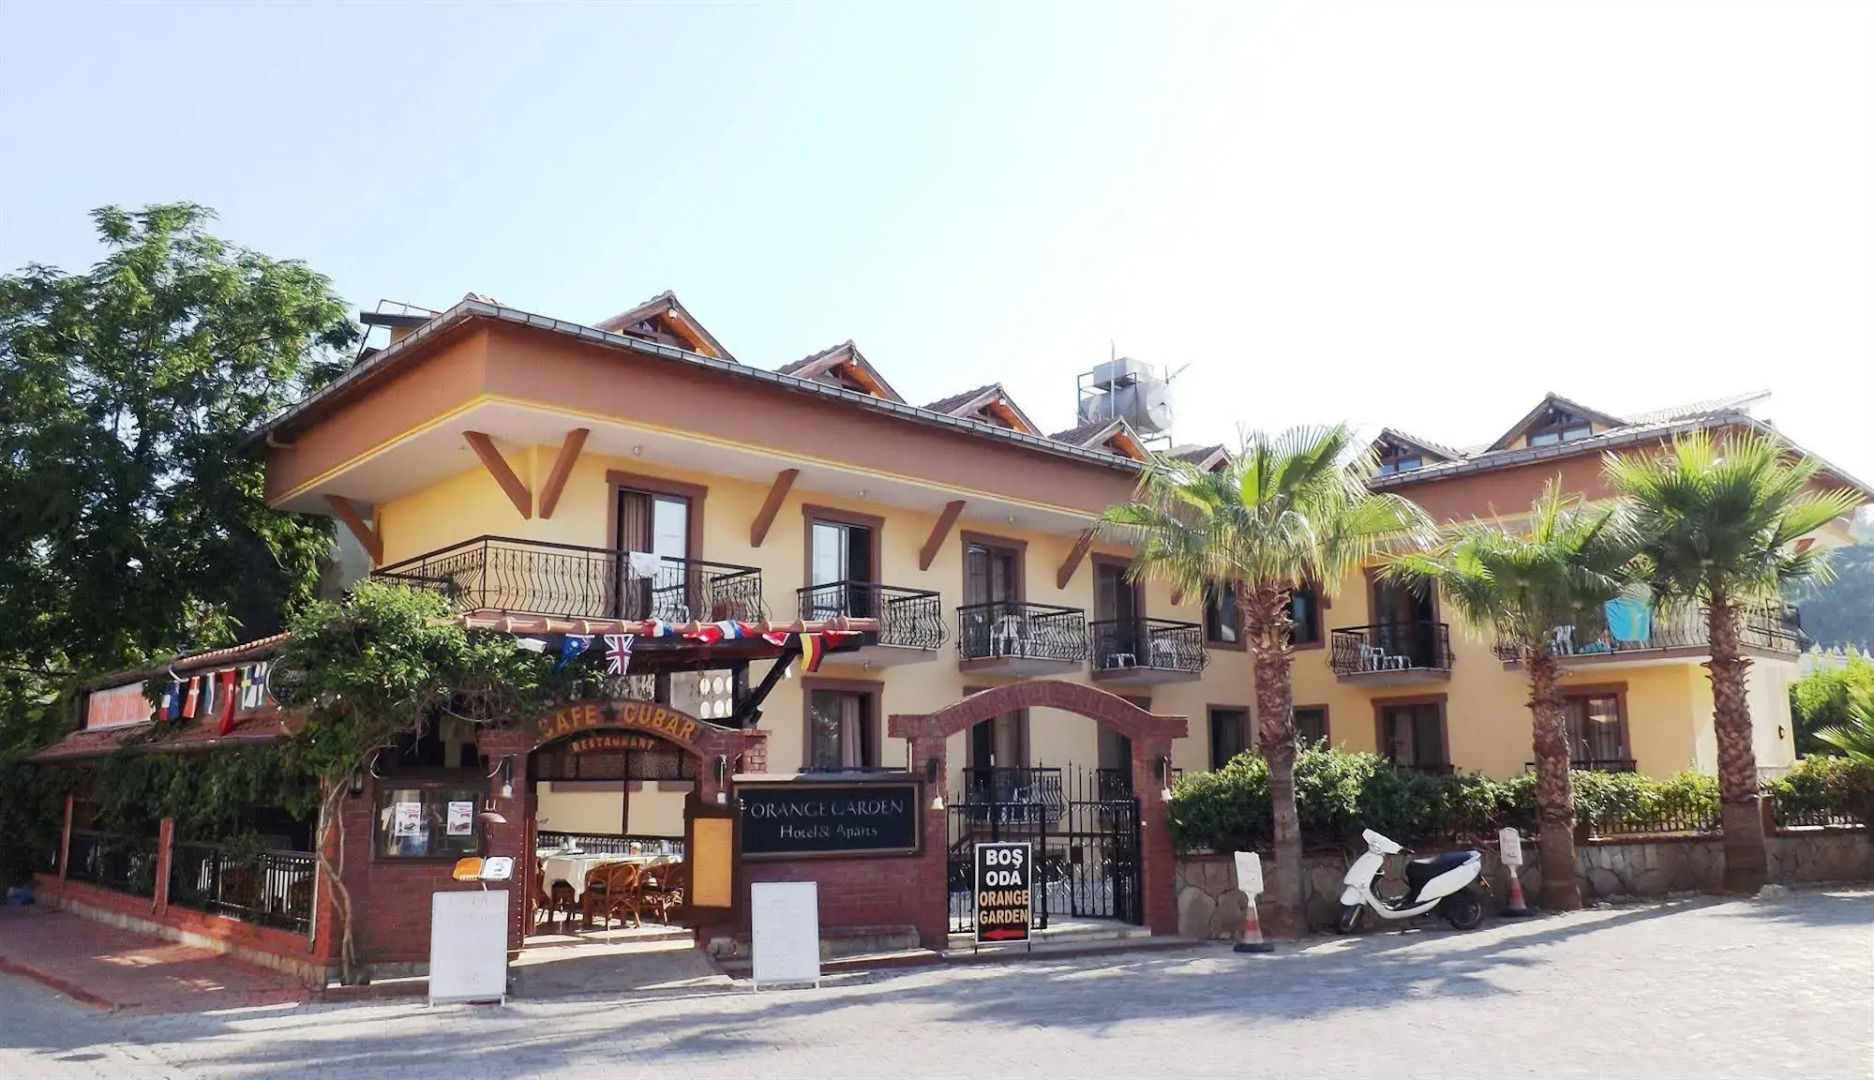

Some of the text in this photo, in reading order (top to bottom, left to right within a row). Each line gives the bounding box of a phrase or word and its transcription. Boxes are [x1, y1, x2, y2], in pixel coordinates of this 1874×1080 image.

[537, 702, 697, 741] CAFE CUBAR
[750, 800, 904, 818] ORANGE GARDEN
[836, 823, 878, 840] Aparts
[986, 849, 1023, 868] BOŞ
[986, 871, 1022, 886] ODA
[980, 890, 1029, 906] ORANGE
[980, 909, 1028, 924] GARDEN
